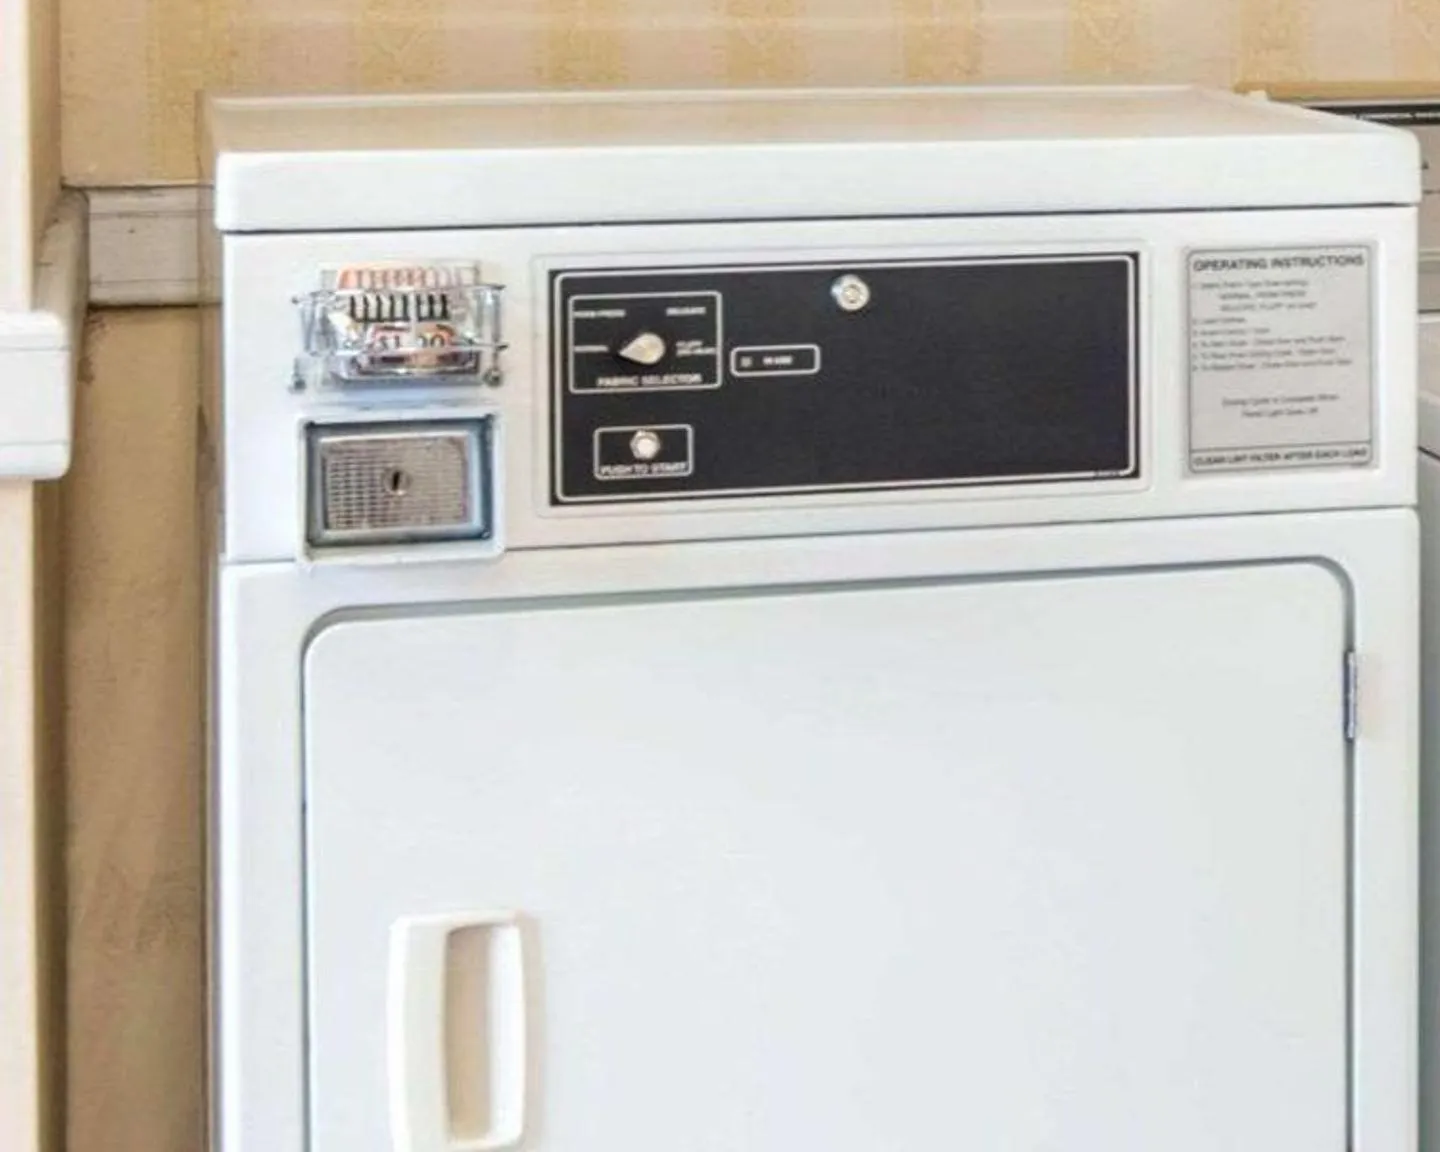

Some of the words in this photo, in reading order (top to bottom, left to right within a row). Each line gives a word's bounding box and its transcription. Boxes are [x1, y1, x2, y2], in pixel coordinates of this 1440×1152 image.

[1193, 257, 1267, 272] OPERATING
[1271, 254, 1364, 269] INSTRUCTIONS
[597, 376, 639, 387] FABRIC
[641, 373, 702, 386] SELECTOR
